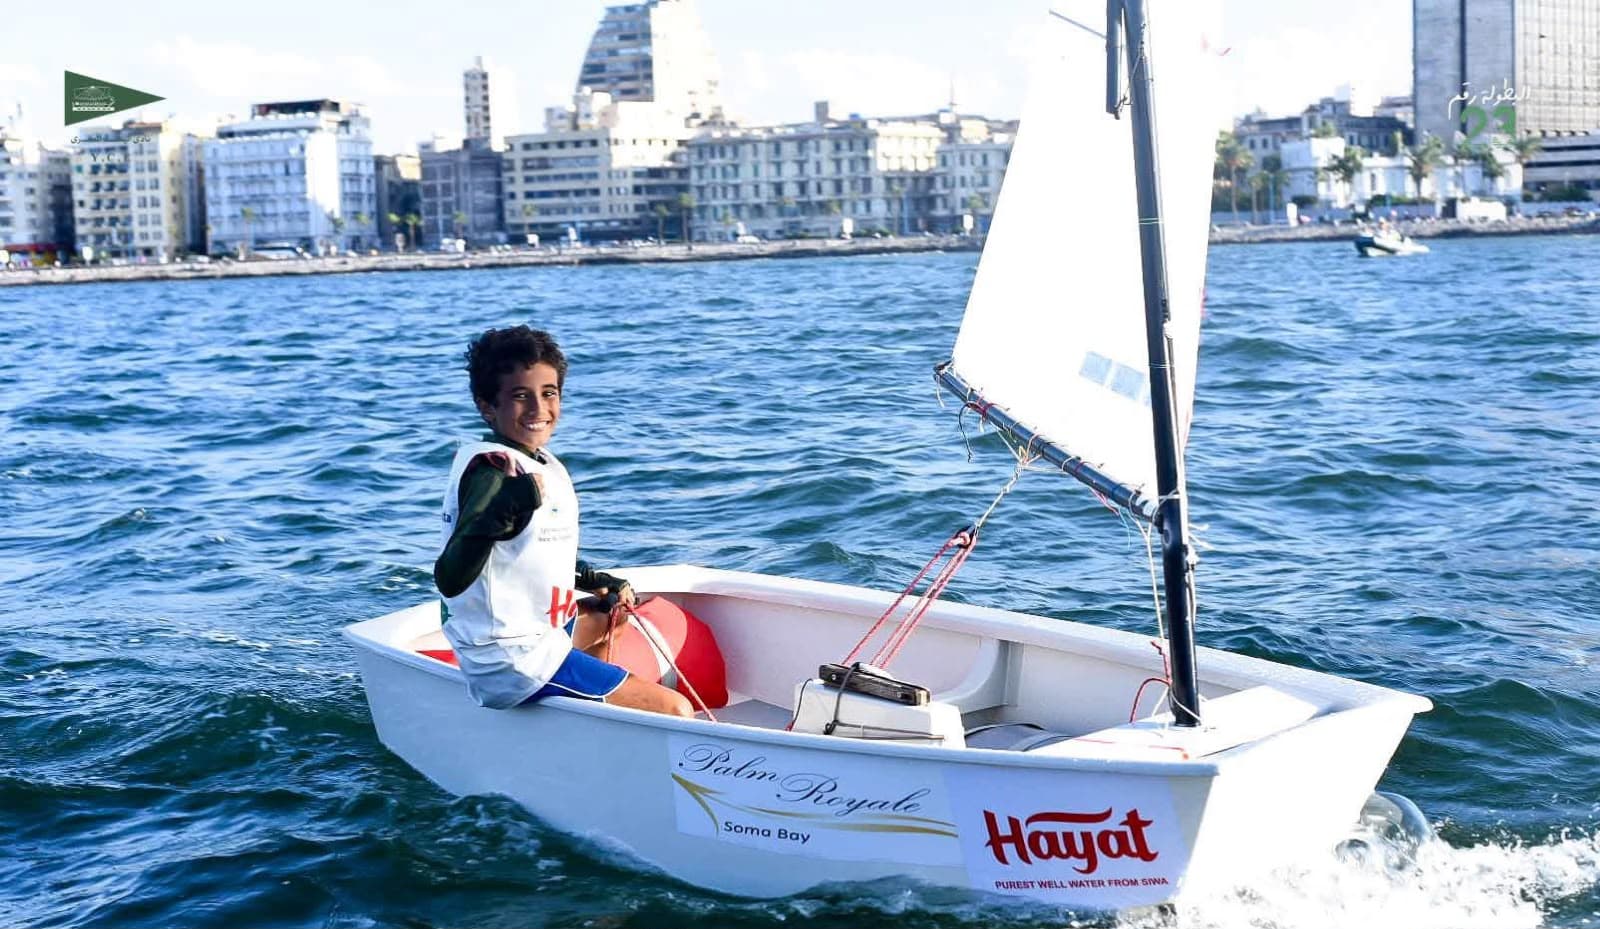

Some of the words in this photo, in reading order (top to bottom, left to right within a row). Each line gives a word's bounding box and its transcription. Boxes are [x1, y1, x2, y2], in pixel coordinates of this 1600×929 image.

[679, 744, 777, 782] Palm
[776, 772, 931, 817] Royale
[723, 820, 771, 838] Soma
[777, 828, 811, 844] Bay
[983, 806, 1159, 875] Hayat
[995, 880, 1035, 890] PUREST
[1037, 879, 1067, 889] WELL
[1068, 878, 1106, 888] WATER
[1108, 878, 1139, 887] FROM
[1141, 877, 1168, 886] SIWA
